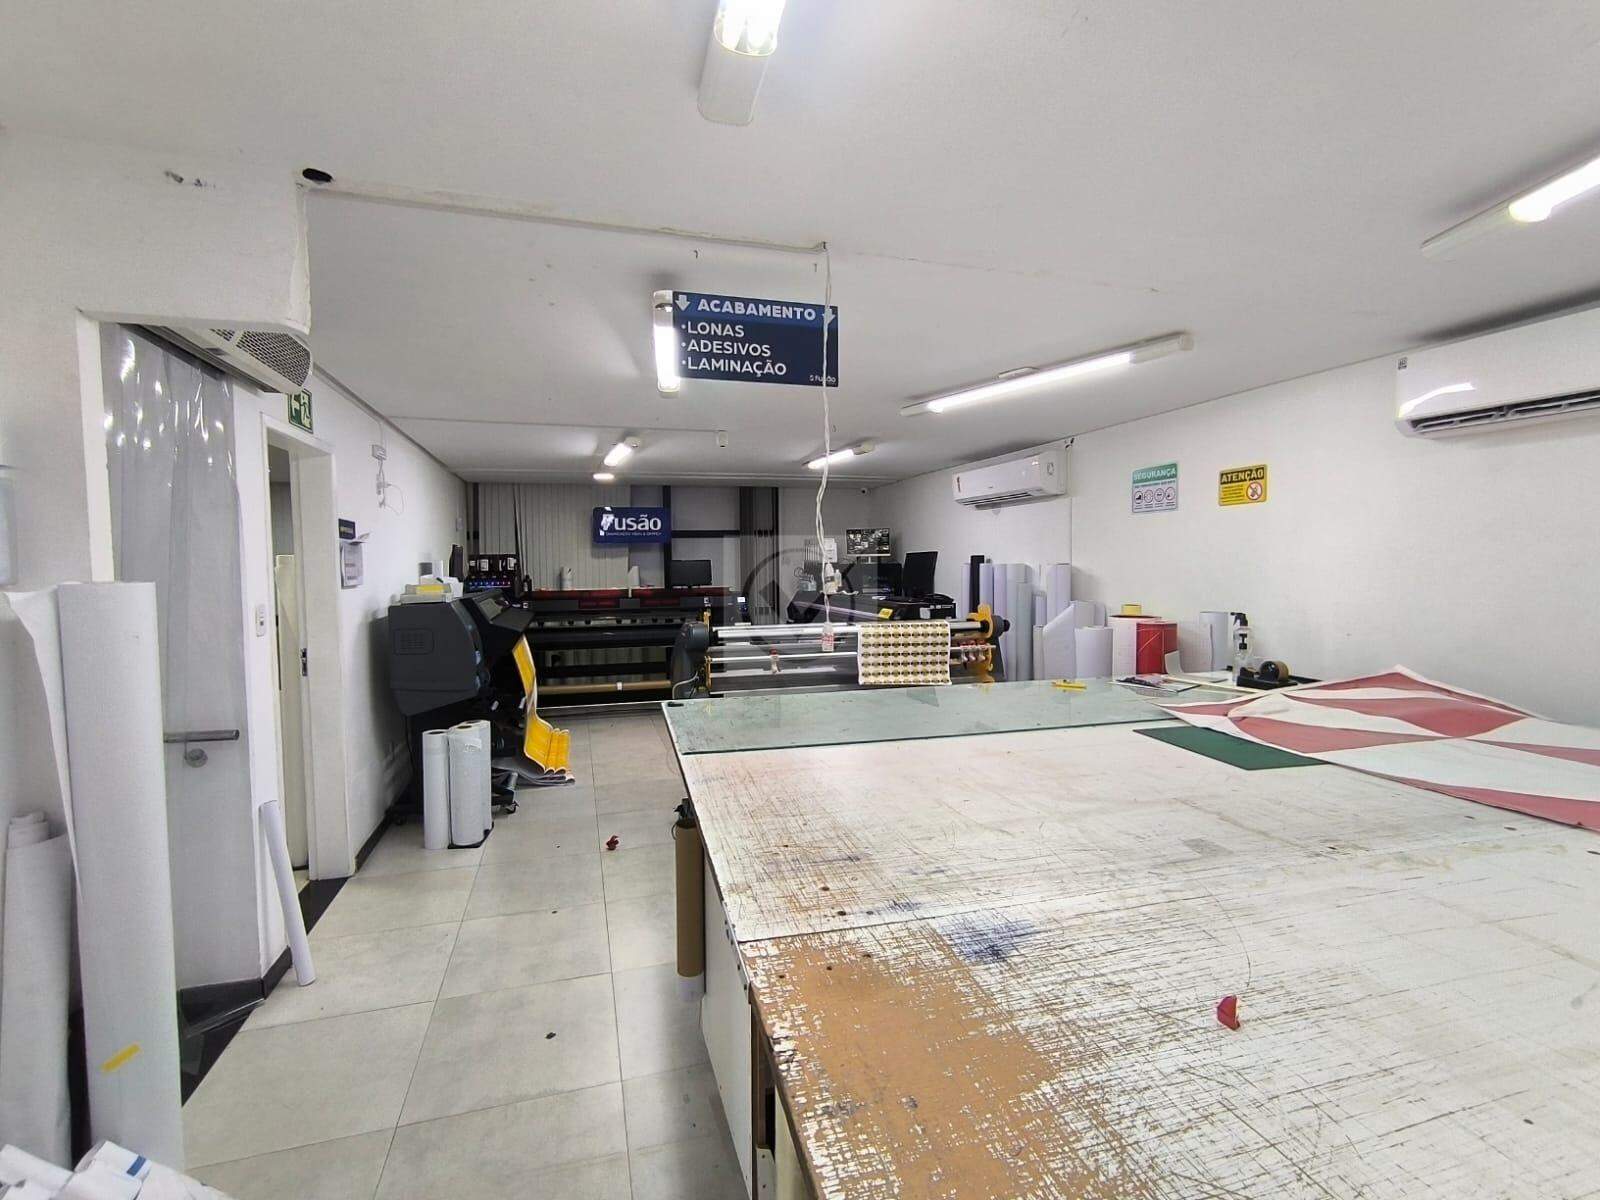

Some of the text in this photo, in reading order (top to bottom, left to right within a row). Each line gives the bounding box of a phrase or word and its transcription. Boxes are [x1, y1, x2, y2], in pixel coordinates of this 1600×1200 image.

[697, 299, 816, 320] ACABAMENTO
[687, 321, 745, 338] LONAS
[687, 339, 771, 357] ADESIVOS
[687, 356, 787, 377] LAMINAÇÃO
